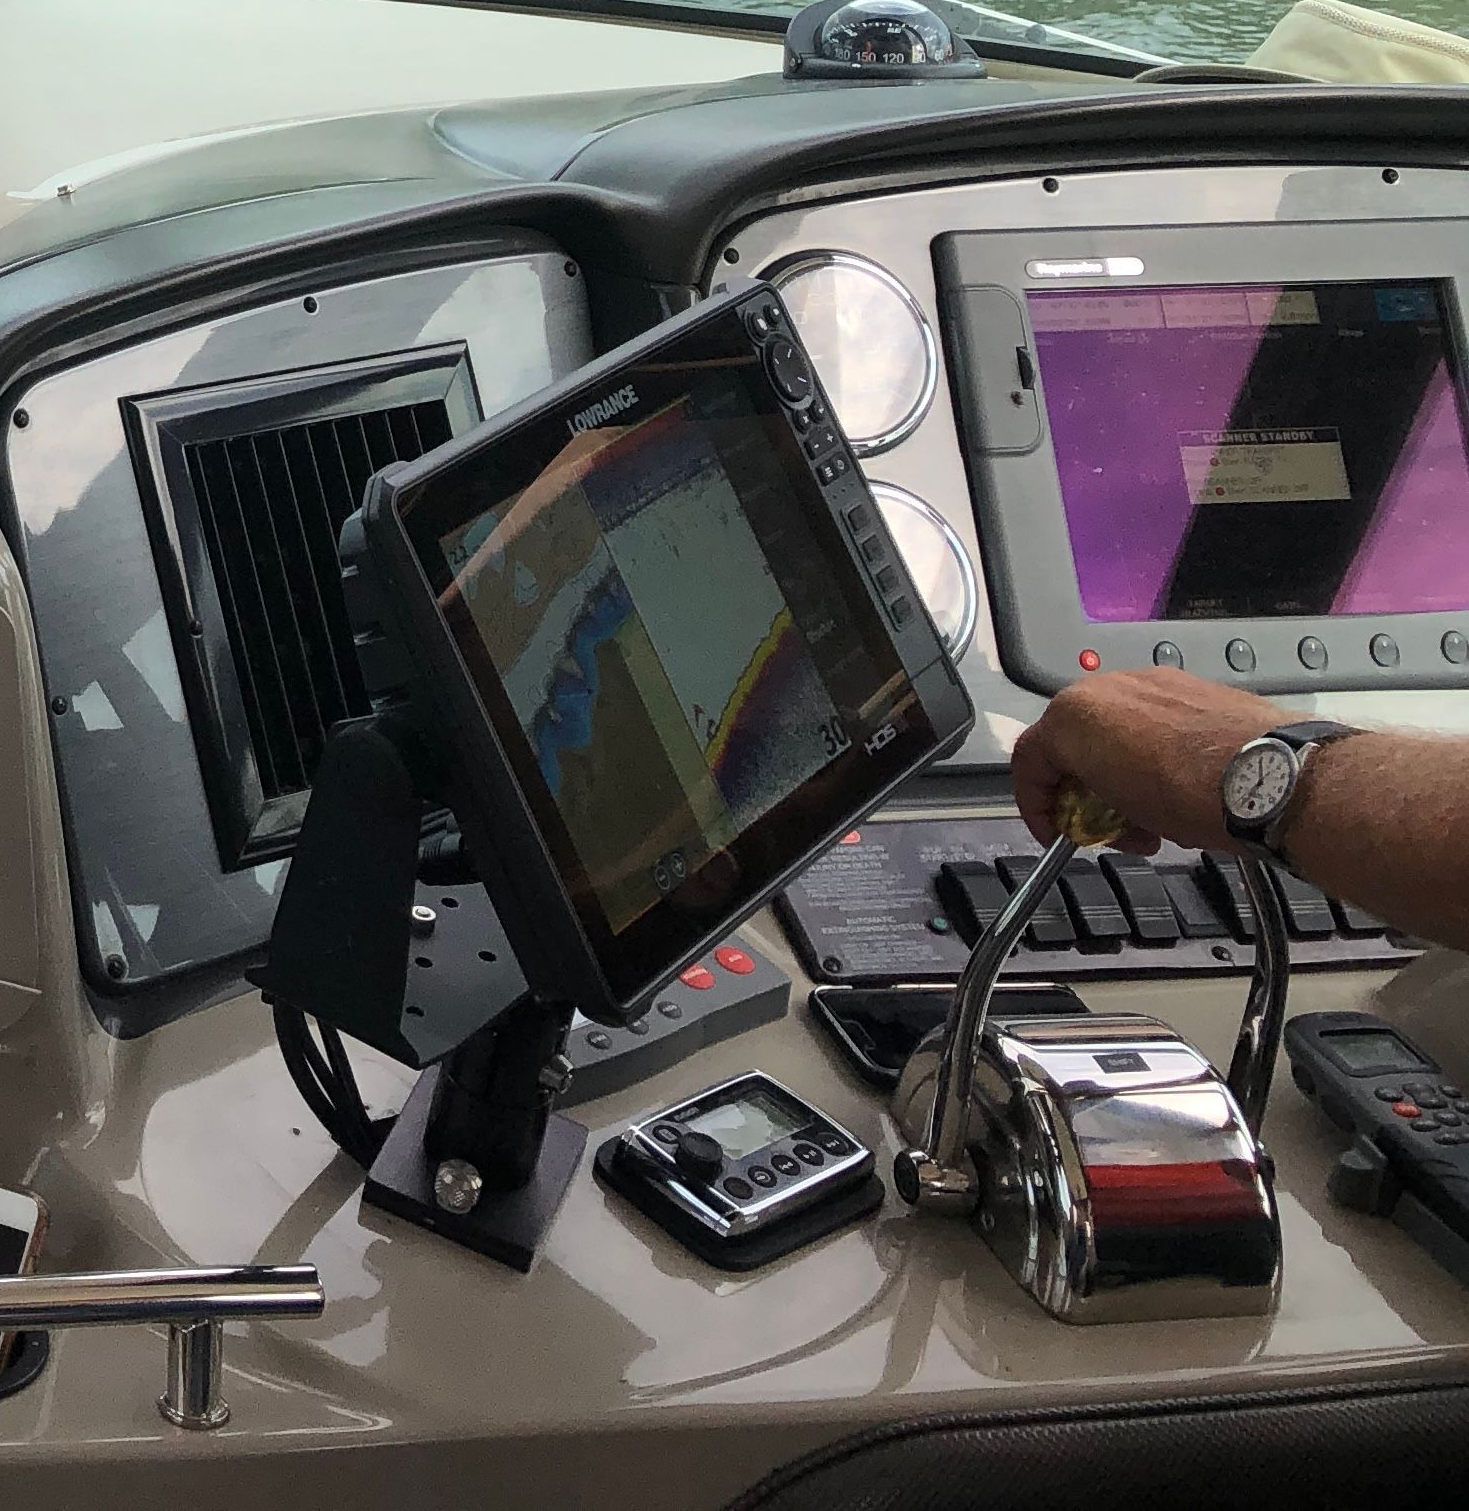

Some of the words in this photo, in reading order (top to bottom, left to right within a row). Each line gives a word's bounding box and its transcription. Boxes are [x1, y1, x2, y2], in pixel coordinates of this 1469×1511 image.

[855, 51, 877, 63] 150
[882, 52, 905, 64] 120
[566, 384, 640, 439] LOWRANCE
[1201, 432, 1258, 444] SCANNER
[1259, 430, 1316, 442] STANDBY
[818, 715, 848, 757] 30
[863, 722, 897, 757] HDS
